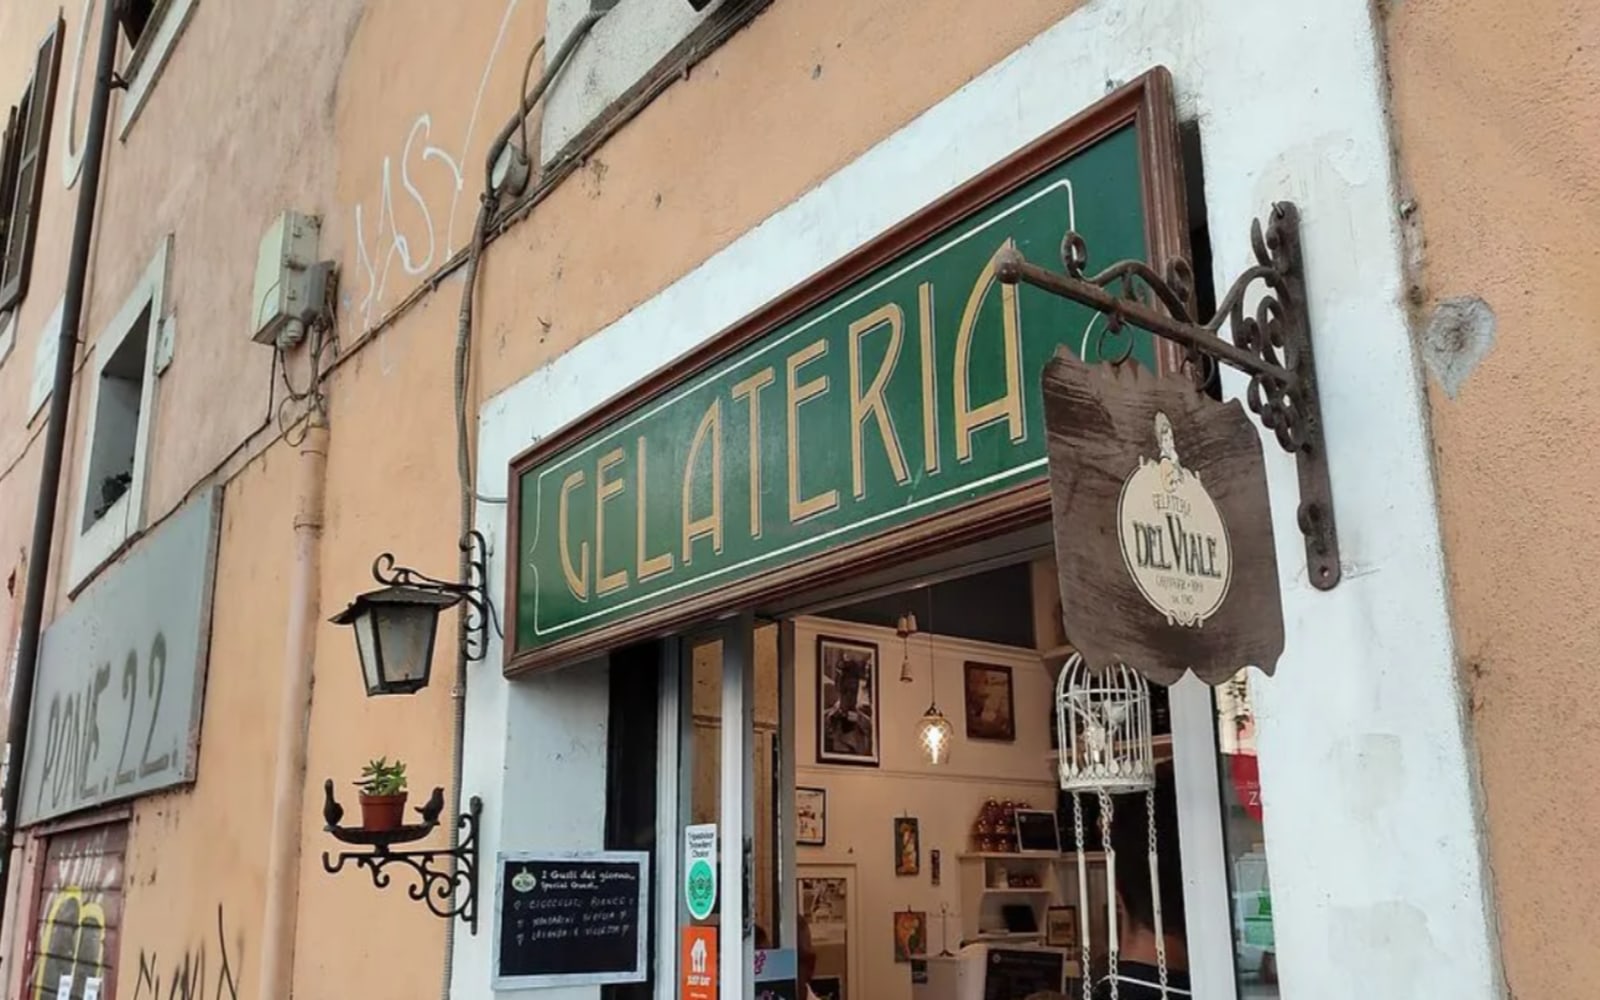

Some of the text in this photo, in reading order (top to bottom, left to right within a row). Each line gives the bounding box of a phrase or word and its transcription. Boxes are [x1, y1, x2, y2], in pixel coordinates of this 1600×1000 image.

[558, 236, 1027, 602] GELATERIA
[1132, 511, 1222, 579] DEL VIALE
